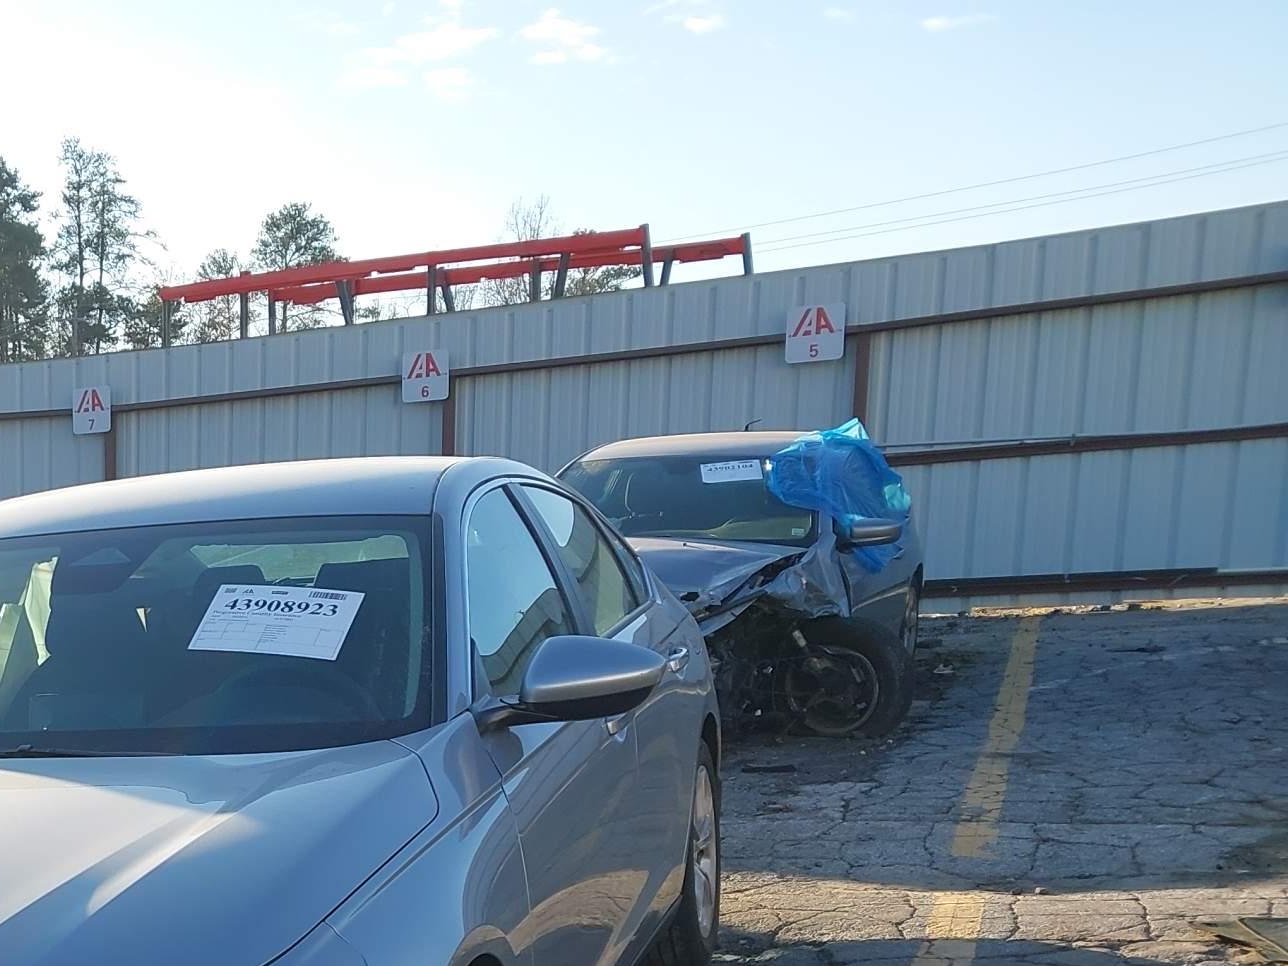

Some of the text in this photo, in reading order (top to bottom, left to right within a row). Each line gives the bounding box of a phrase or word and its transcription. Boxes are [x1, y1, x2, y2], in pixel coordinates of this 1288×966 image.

[809, 344, 819, 358] 5
[421, 386, 430, 399] 6
[88, 419, 96, 431] 7
[224, 598, 339, 617] 43908923
